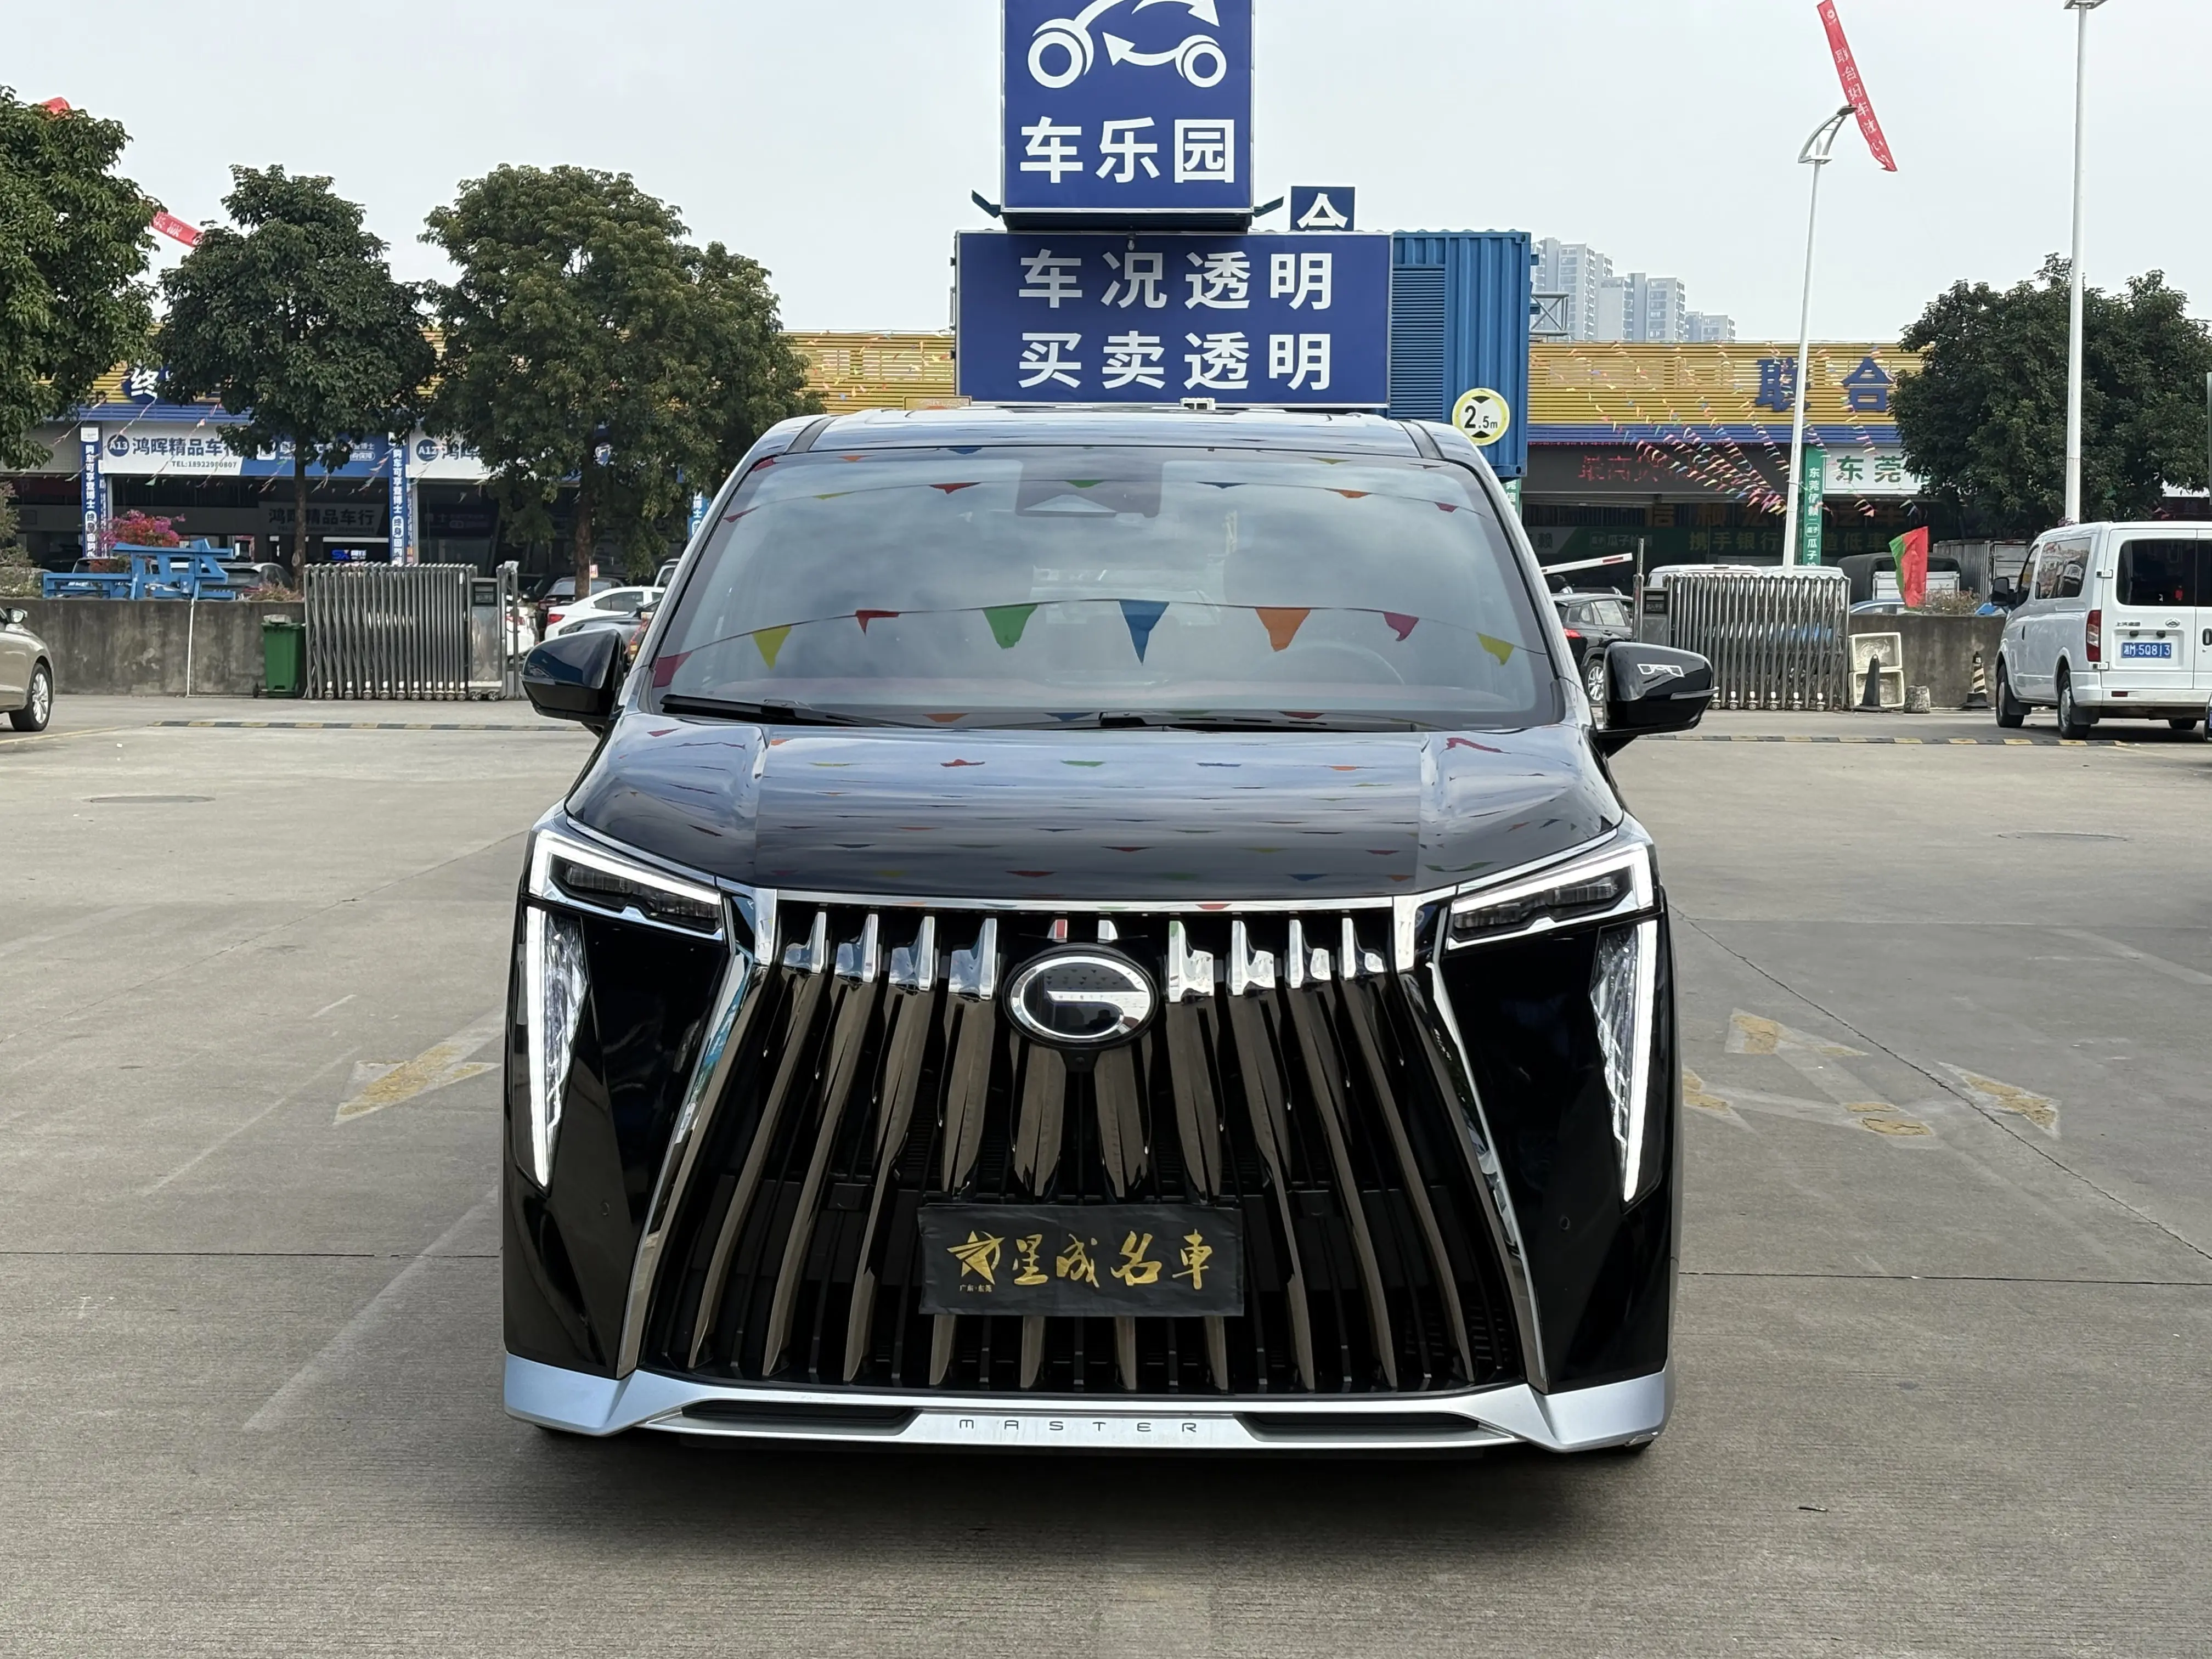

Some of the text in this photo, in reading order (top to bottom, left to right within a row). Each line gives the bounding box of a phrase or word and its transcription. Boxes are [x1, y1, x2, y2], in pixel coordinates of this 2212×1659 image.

[1020, 116, 1234, 183] 车乐园
[1019, 249, 1332, 309] 车况透明
[1018, 331, 1331, 390] 买卖透明
[1464, 405, 1498, 428] 2.5m
[109, 441, 128, 450] A13
[959, 1419, 1197, 1433] MASTER
